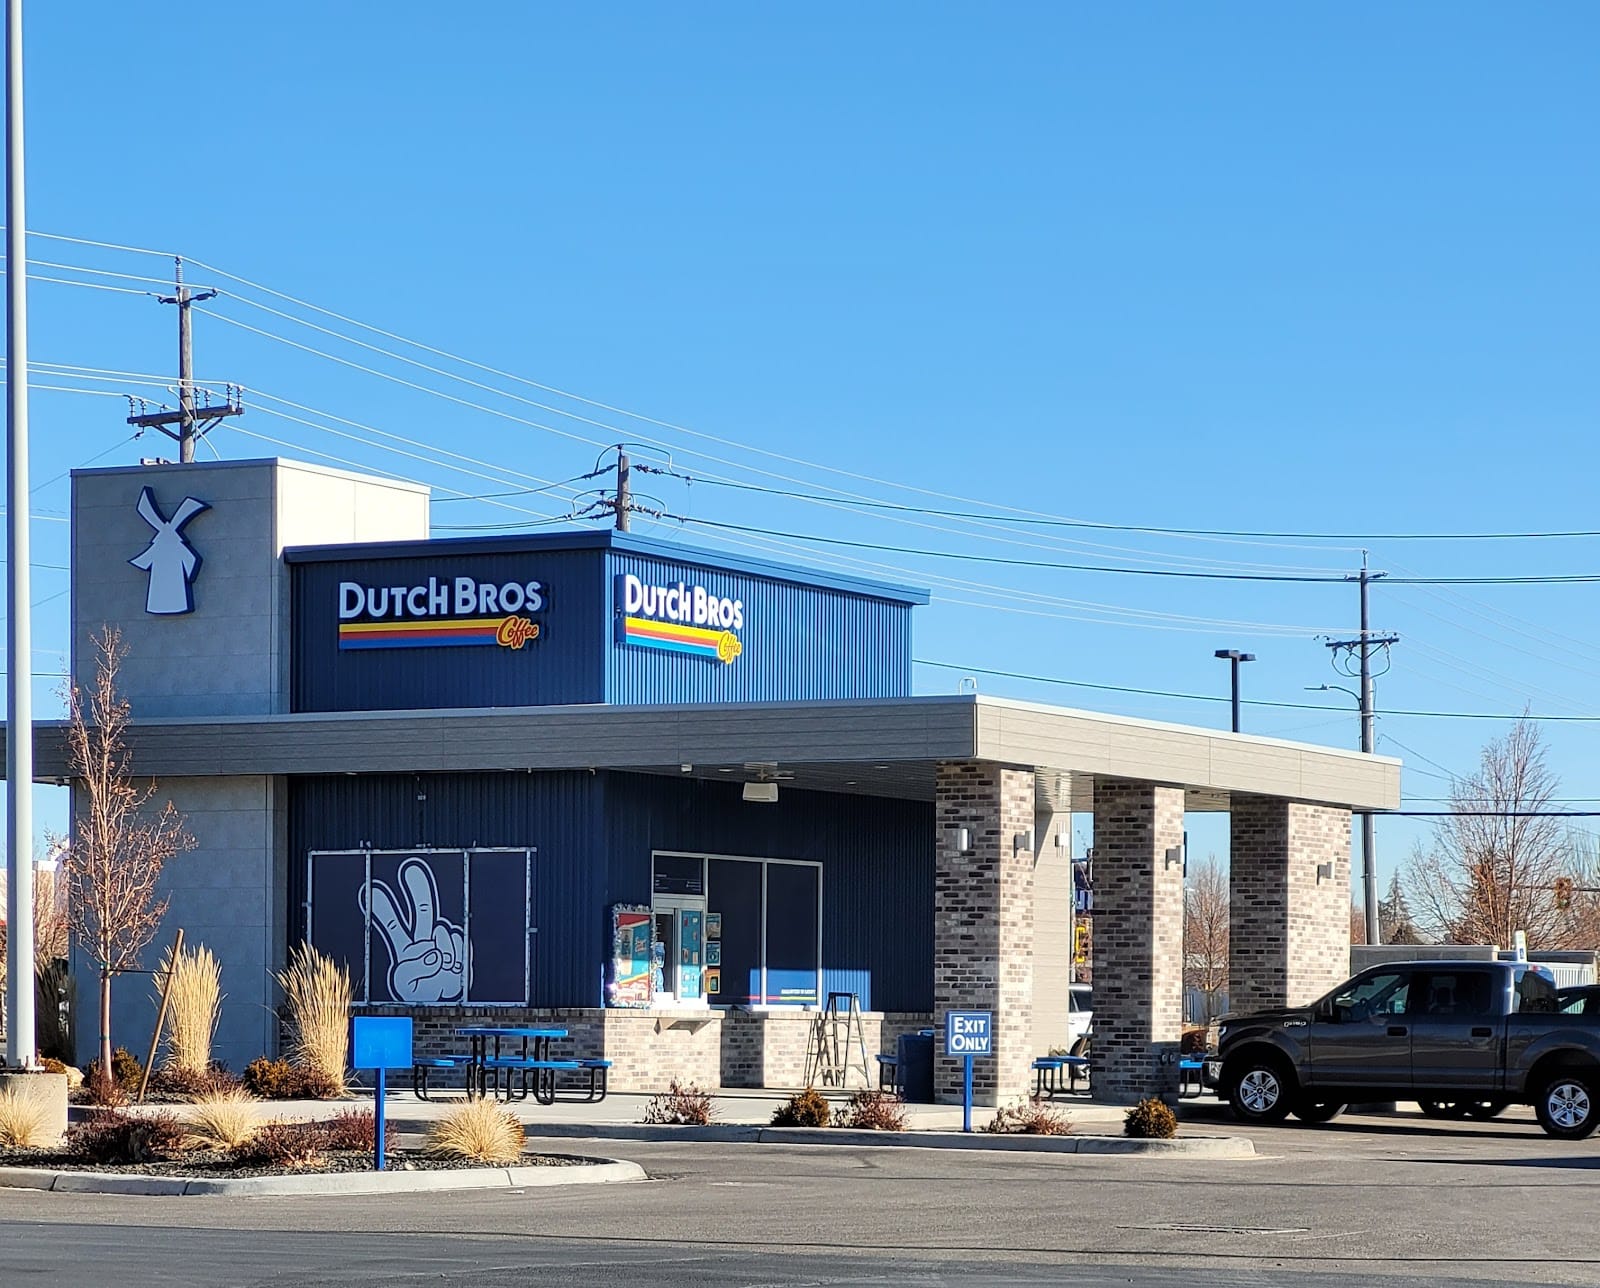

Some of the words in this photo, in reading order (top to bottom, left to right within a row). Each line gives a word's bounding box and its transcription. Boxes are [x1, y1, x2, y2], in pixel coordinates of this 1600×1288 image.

[339, 577, 448, 618] DUTCH
[455, 577, 542, 614] BROS
[625, 574, 691, 621] DUTCH
[694, 586, 743, 630] BROS
[498, 616, 538, 648] Coffee
[954, 1017, 986, 1033] EXIT
[952, 1034, 988, 1050] ONLY
